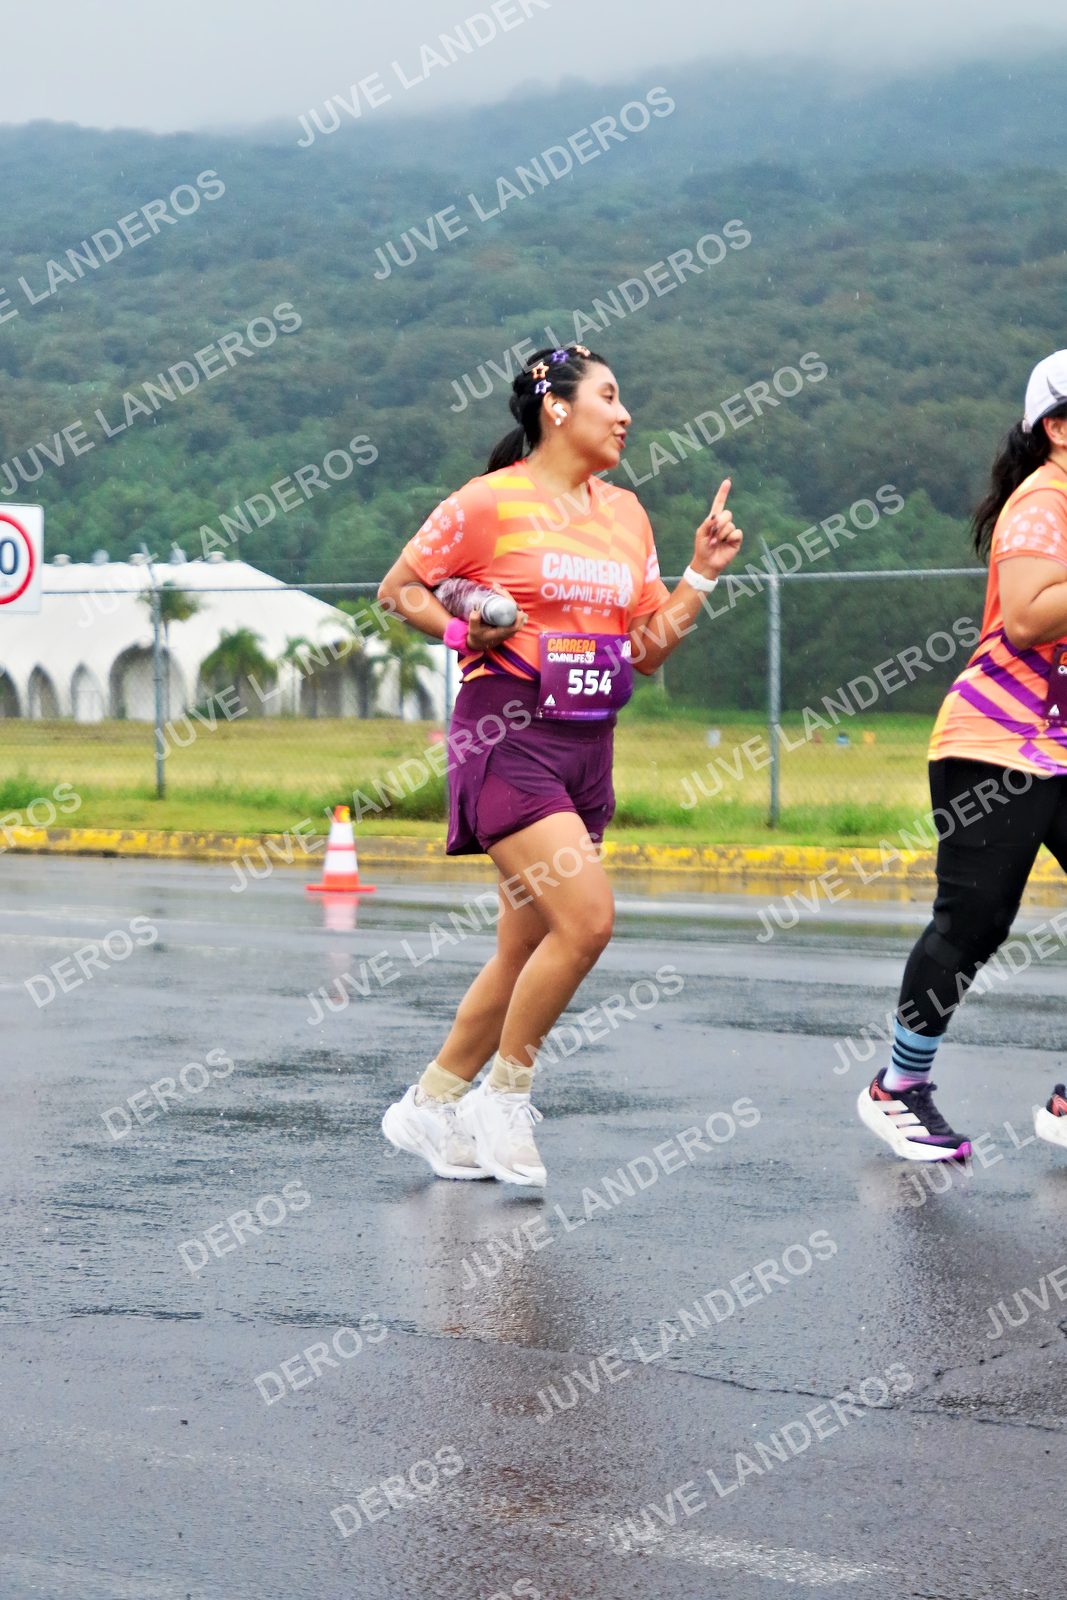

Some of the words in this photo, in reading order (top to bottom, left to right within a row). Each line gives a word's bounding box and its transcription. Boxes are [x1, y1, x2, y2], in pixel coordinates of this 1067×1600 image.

[542, 552, 633, 590] CARRERA
[540, 582, 613, 606] OMNILIFE
[547, 638, 597, 653] CARRERA
[567, 668, 612, 695] 554
